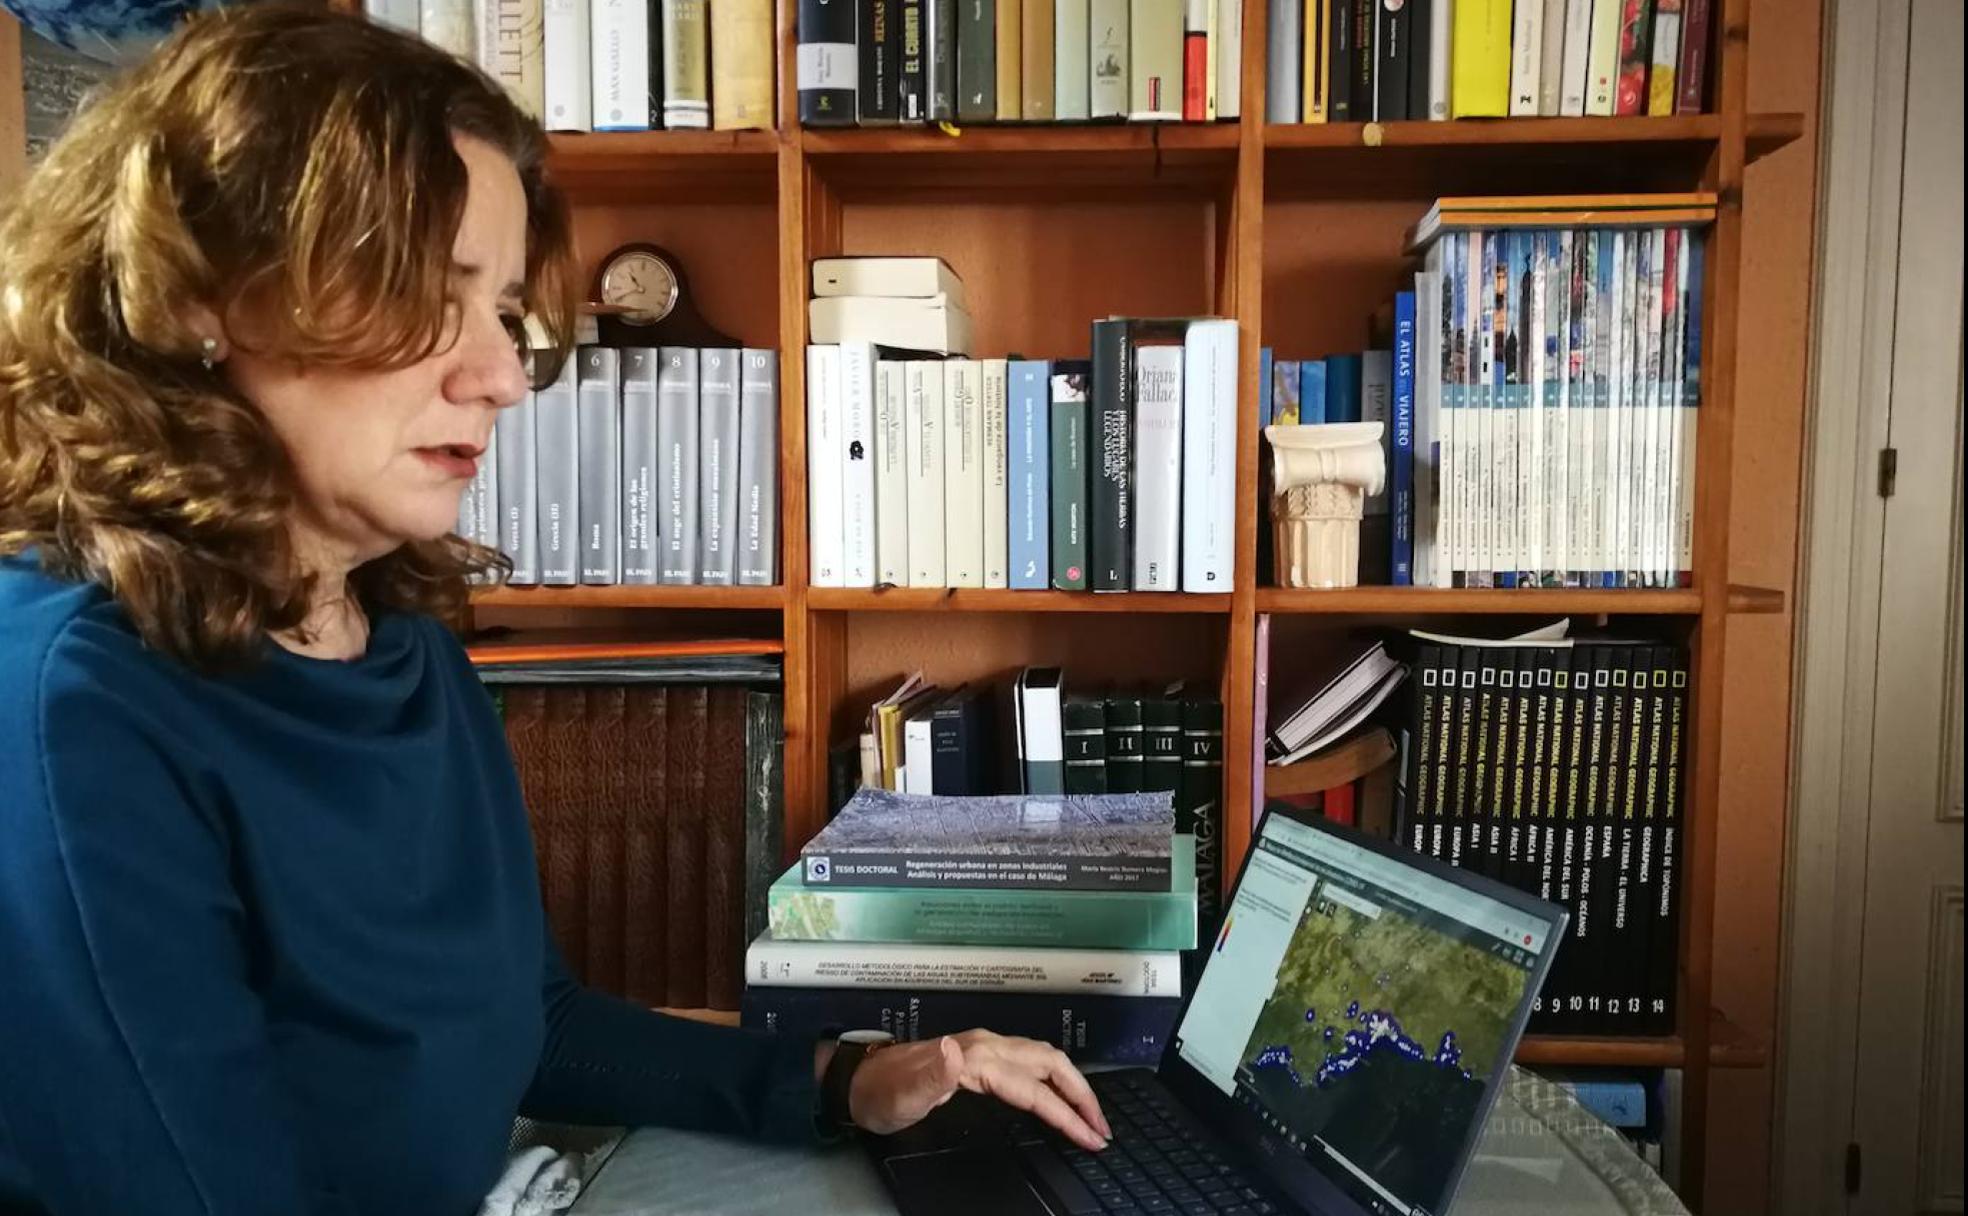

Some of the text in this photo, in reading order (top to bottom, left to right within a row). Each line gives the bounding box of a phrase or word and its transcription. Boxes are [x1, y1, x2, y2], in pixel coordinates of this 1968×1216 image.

[904, 56, 920, 74] EL
[1399, 320, 1411, 335] EL
[590, 354, 600, 367] 6
[634, 355, 643, 367] 7
[671, 356, 682, 367] 8
[711, 356, 721, 369] 9
[751, 356, 765, 369] 10
[1399, 339, 1411, 377] ATLAS
[1399, 394, 1410, 447] VIAJERO
[1104, 410, 1113, 478] LEGENDARIOS
[1118, 410, 1128, 529] HISTORIA LAS TIERRAS
[629, 479, 639, 538] origen las
[638, 466, 649, 550] grandes religiones
[672, 443, 683, 551] El auge del cristianismo
[710, 438, 719, 552] La musulmana
[750, 485, 760, 551] La Edad Media
[1070, 503, 1078, 530] MORTON
[511, 521, 520, 551] Grecia
[551, 521, 561, 551] Grecia
[591, 524, 601, 550] Roma
[1423, 695, 1432, 720] ATLAS
[1462, 698, 1471, 723] ATLAS
[1482, 693, 1491, 720] ATLAS
[1519, 697, 1528, 724] ATLAS
[1538, 695, 1547, 721] ATLAS
[1613, 695, 1622, 721] ATLAS
[1672, 697, 1681, 723] ATLAS
[1082, 740, 1089, 754] I
[1118, 737, 1133, 750] II
[1154, 737, 1173, 750] III
[1193, 742, 1211, 755] IV
[1420, 723, 1430, 762] NATIONAL
[1460, 725, 1468, 765] NATIONAL
[1478, 722, 1488, 762] NATIONAL
[1516, 725, 1526, 766] NATIONAL
[1534, 723, 1544, 764] NATIONAL
[1609, 723, 1619, 763] NATIONAL
[1670, 725, 1679, 765] NATIONAL
[1432, 695, 1451, 856] ATLAS NATIONAL GEOGRAPHIC EUROPA
[1490, 697, 1509, 846] ATLAS NATIONAL GEOGRAPHIC ASIA
[1513, 767, 1523, 819] GEOGRAPHIC
[1530, 766, 1541, 817] GEOGRAPHIC
[1542, 697, 1564, 881] ATLAS NATIONAL GEOGRAPHIC AMÉRICA DEL
[1560, 698, 1584, 900] ATLAS NATIONAL GEOGRAPHIC AMÉRICA DEL SUR
[1640, 697, 1663, 883] ATLAS NATIONAL GEOGRAPHIC GEOGRAPHICA
[1577, 695, 1604, 938] ATLAS NATIONAL GEOGRAPHIC OCEANÍA POLOS OCÉANOS
[1615, 697, 1642, 929] ATLAS NATIONAL GEOGRAPHIC LA TIERRA EL UNIVERSO
[1452, 826, 1462, 858] EUROPA
[1472, 823, 1481, 843] ASIA
[1602, 826, 1612, 858] ESPAÑA
[835, 865, 899, 874] TESIS DOCTORAL
[906, 859, 959, 871] Regeneración
[960, 861, 985, 870] urbana
[1022, 862, 1068, 872] industriales
[1663, 856, 1672, 868] DE
[907, 870, 937, 880] Análisis
[944, 872, 985, 883] propuestas
[1027, 872, 1038, 881] de
[1038, 871, 1067, 883] Málaga
[1110, 873, 1124, 881] AÑO
[1660, 869, 1671, 917] TOPÓNIMOS
[815, 968, 840, 976] RIESGO
[818, 961, 860, 969] DESARROLLO
[861, 962, 913, 970] METODOLÓGICO
[1552, 998, 1560, 1013] 9
[1569, 995, 1582, 1011] 10
[1588, 996, 1600, 1011] 11
[1607, 999, 1620, 1014] 12
[1627, 997, 1640, 1012] 13
[1652, 999, 1664, 1013] 14
